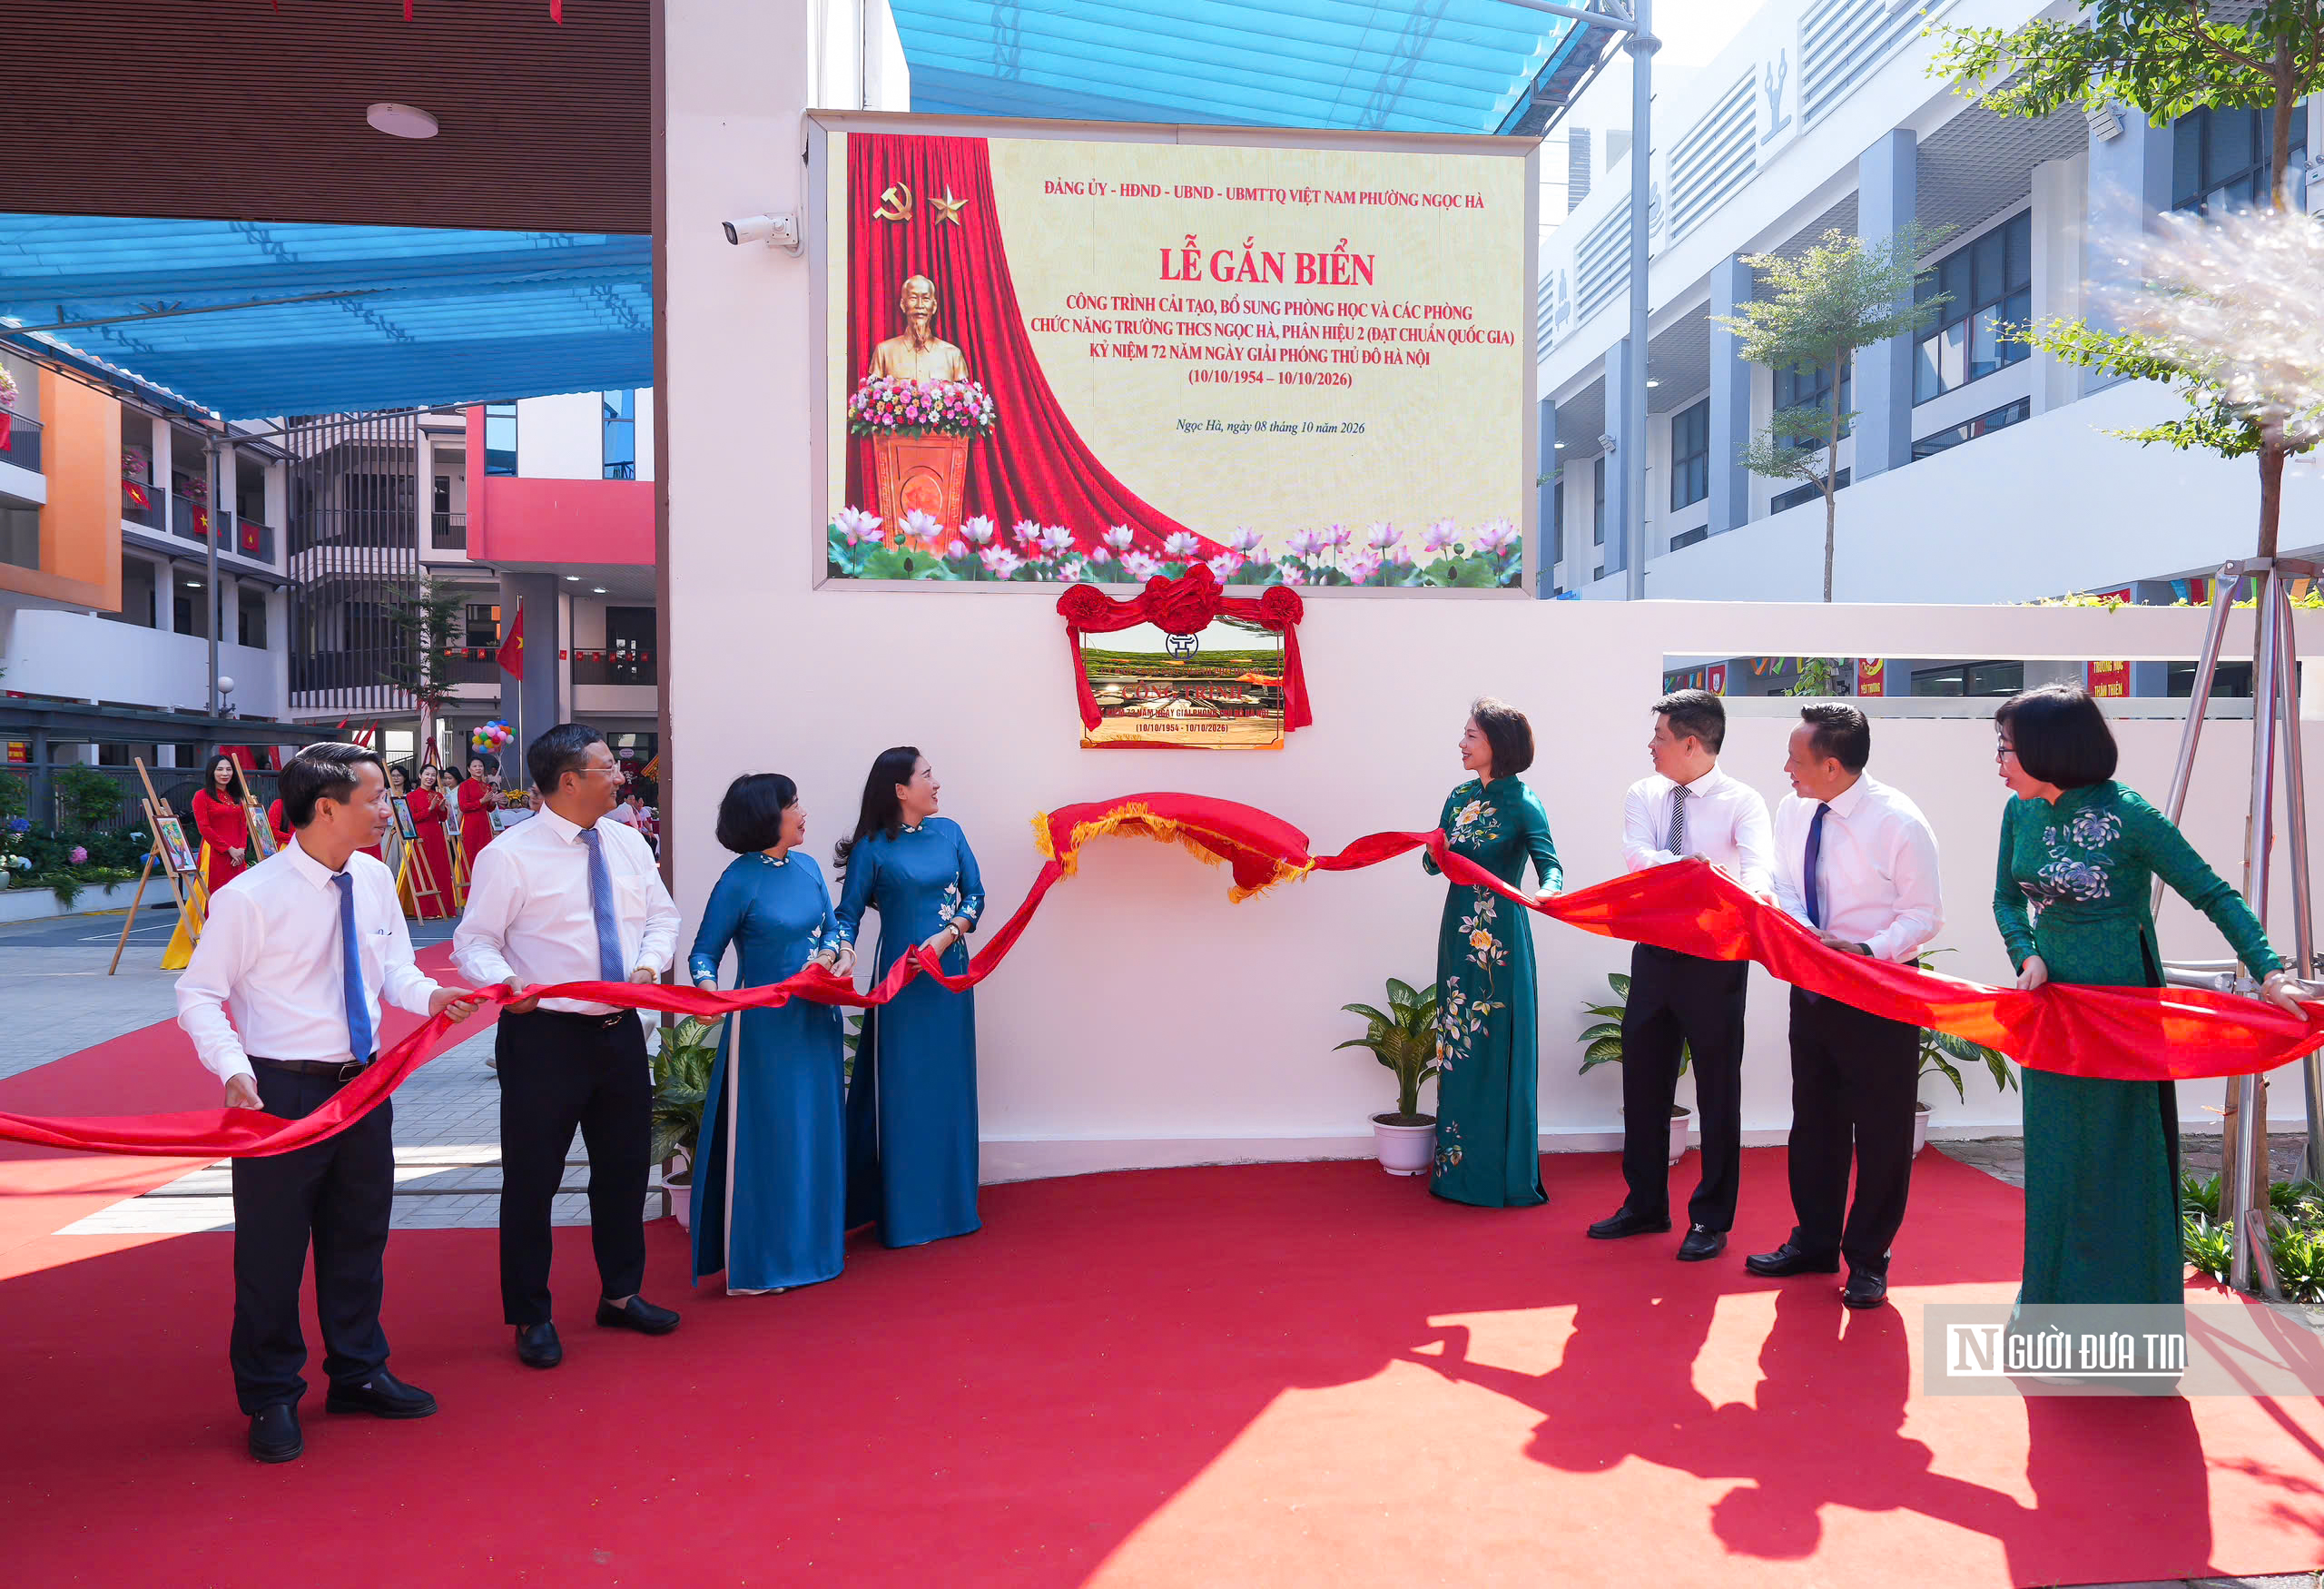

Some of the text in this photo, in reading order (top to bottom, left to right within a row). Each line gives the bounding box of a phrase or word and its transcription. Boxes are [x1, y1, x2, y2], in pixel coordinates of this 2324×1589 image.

[1044, 177, 1085, 195] ĐẢNG
[1088, 178, 1108, 196] ỦY
[1120, 183, 1161, 198] HĐND
[1174, 185, 1214, 200] UBND
[1226, 186, 1286, 204] UBMTTQ
[1289, 186, 1321, 206] VIỆT
[1324, 190, 1356, 204] NAM
[1359, 189, 1419, 207] PHƯỜNG
[1423, 193, 1462, 211] NGỌC
[1465, 192, 1484, 209] HÀ
[1159, 233, 1375, 286] LỄ GẮN BIỂN
[1066, 291, 1472, 321] CÔNG TRÌNH CẢI TẠO, BỔ SUNG PHÒNG HỌC VÀ CÁC PHÒNG
[1030, 315, 1515, 347] CHỨC NĂNG TRƯỜNG THCS NGỌC HÀ, PHÂN HIỆU 2 (ĐẠT CHUẨN QUỐC GIA)
[1089, 340, 1431, 368] KỶ NIỆM 72 NĂM NGÀY GIẢI PHÓNG THỦ ĐÔ HÀ NỘI
[1188, 370, 1264, 386] (10/10/1954
[1278, 371, 1353, 389] 10/10/2026)
[1176, 419, 1365, 435] Ngọc Hà, ngày 08 tháng 10 năm 2026
[1122, 680, 1243, 699] CÔNG TRÌNH
[1136, 724, 1179, 732] (10/10/1954
[1186, 724, 1228, 732] 10/10/2026)
